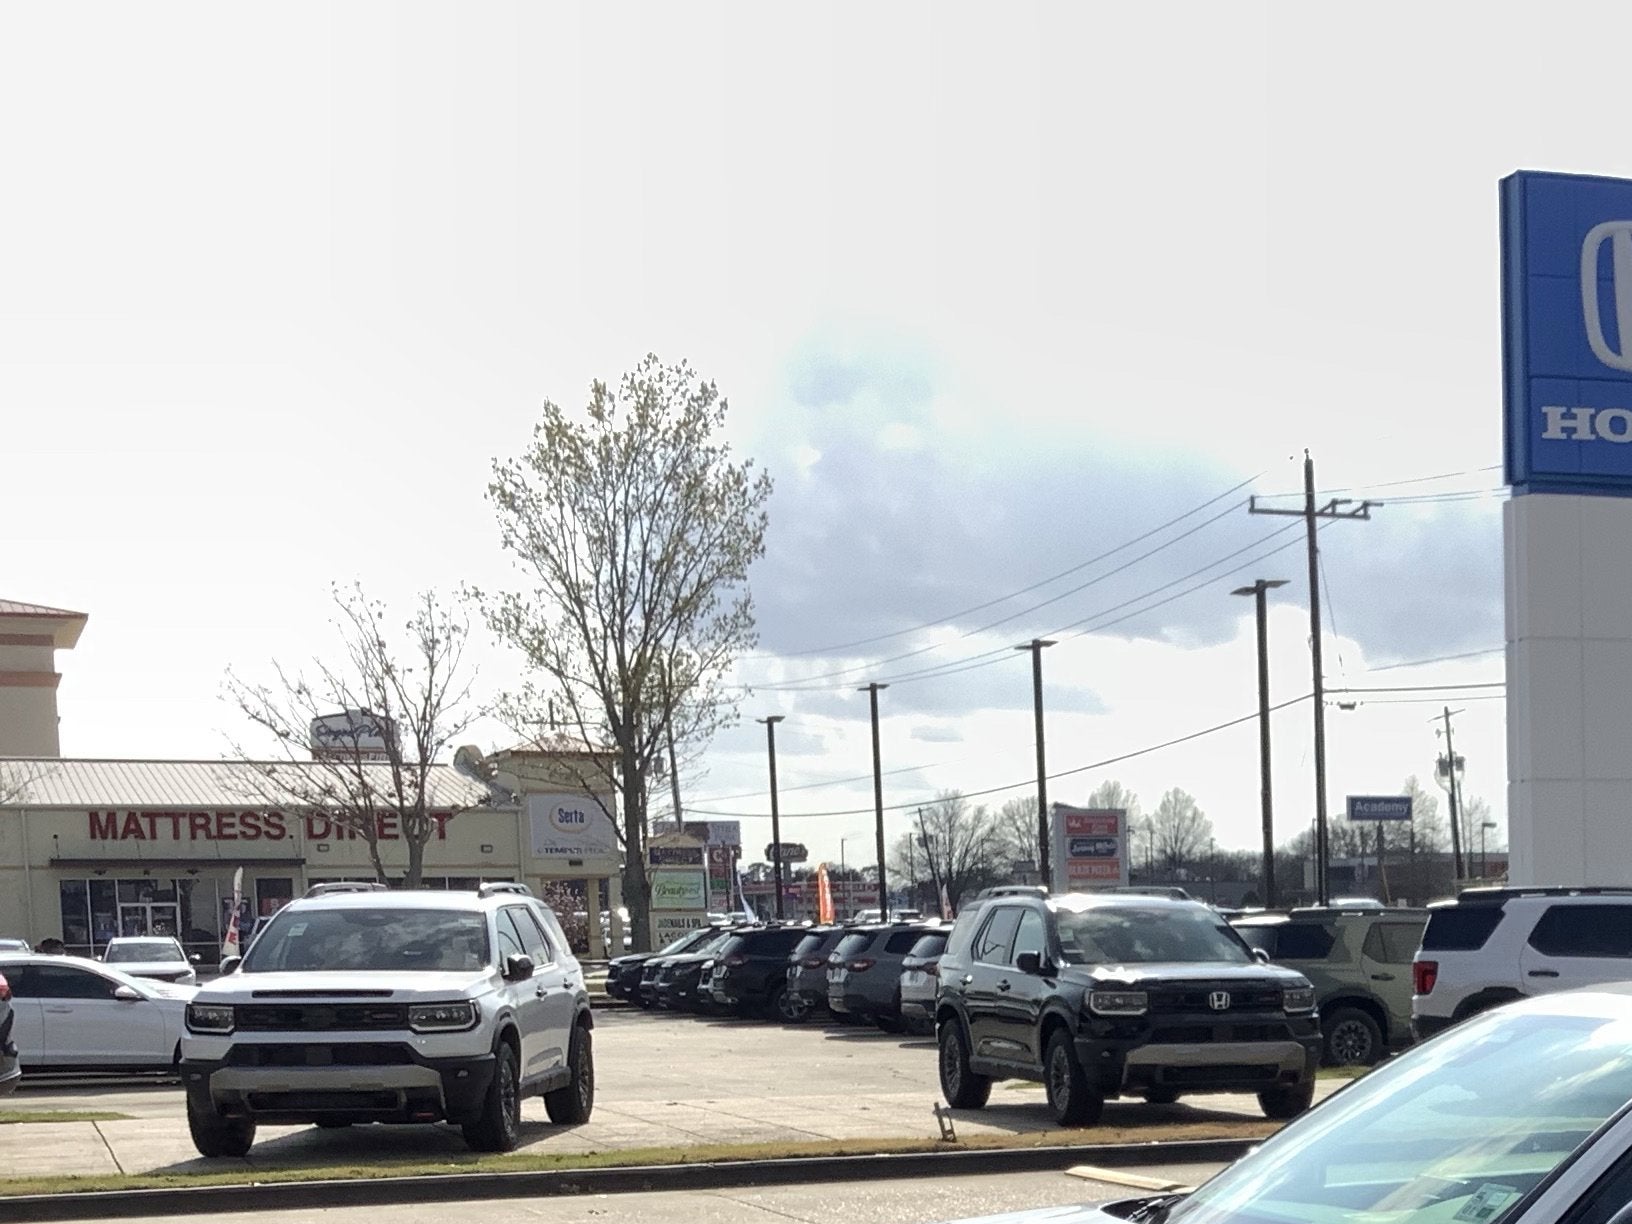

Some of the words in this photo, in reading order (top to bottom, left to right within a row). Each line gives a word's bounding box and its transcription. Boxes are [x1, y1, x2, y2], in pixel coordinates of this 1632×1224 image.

[557, 807, 585, 824] Serta
[1354, 801, 1409, 816] Academy
[88, 811, 287, 841] MATTRESS
[305, 811, 452, 840] DIET
